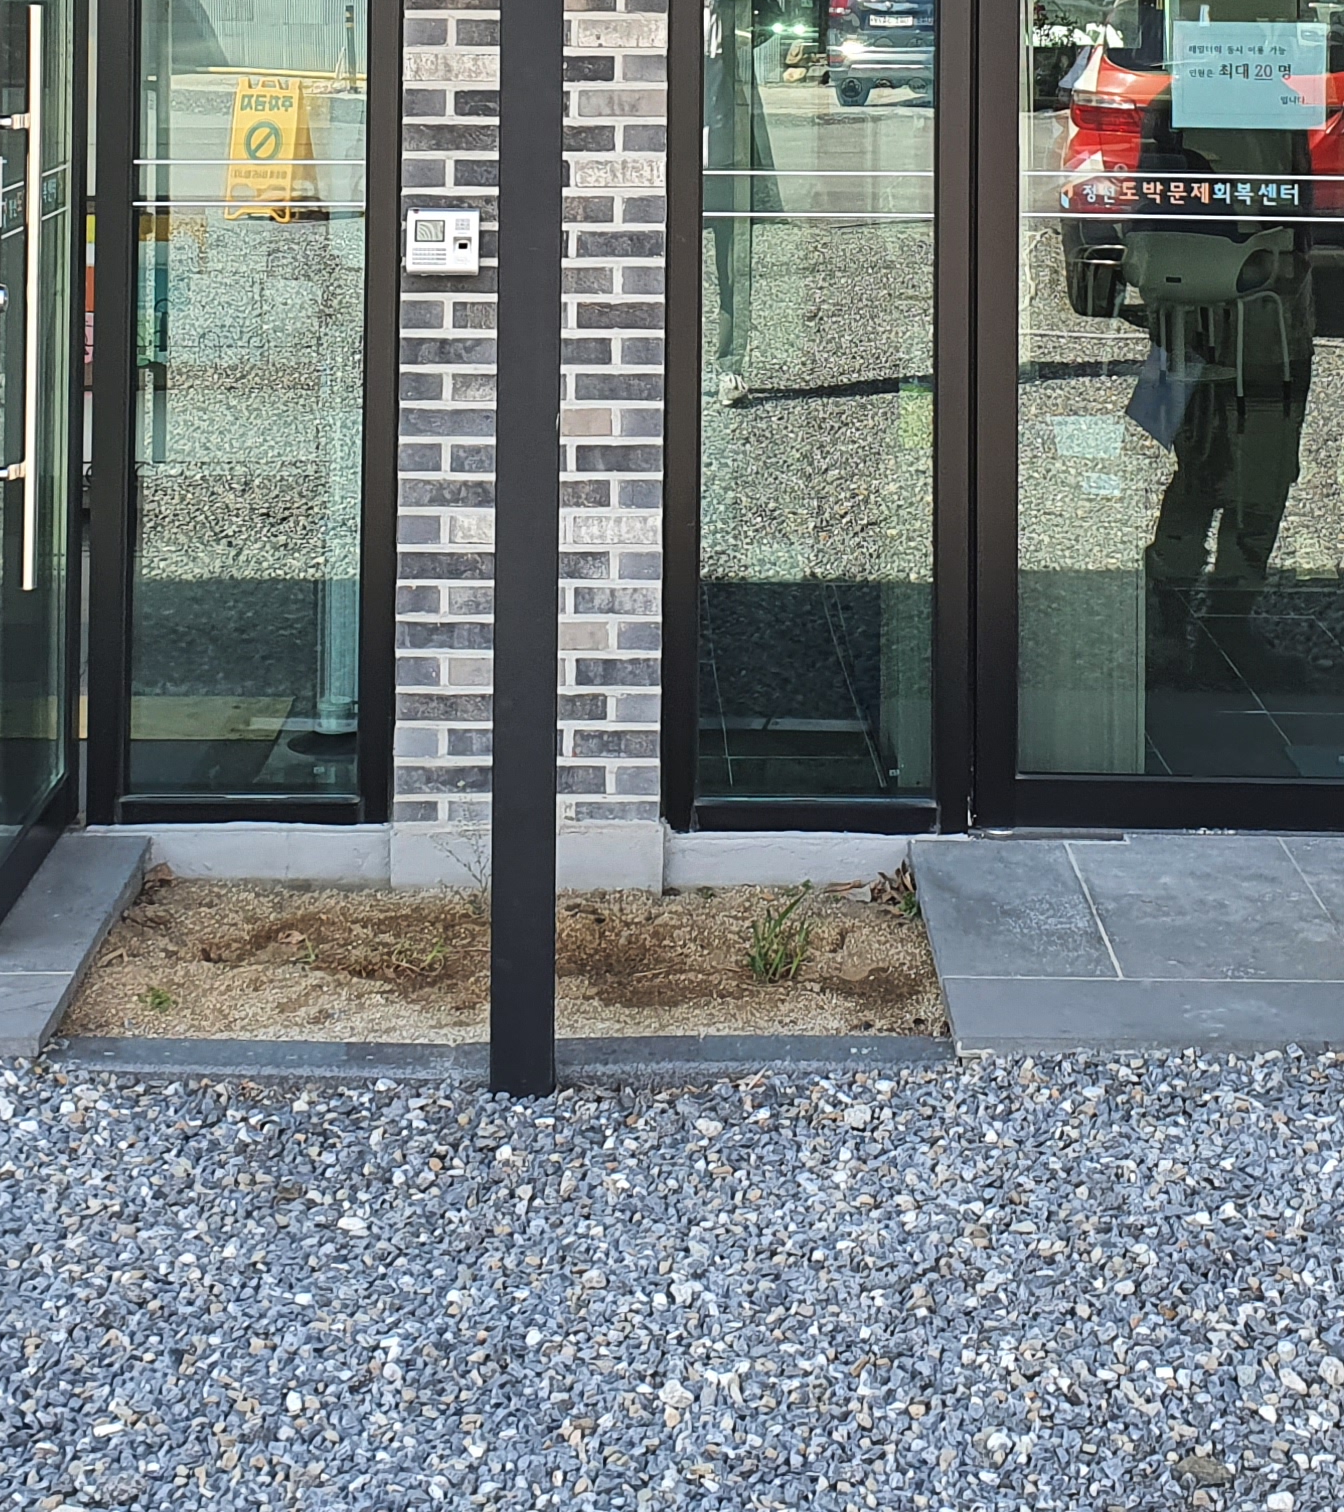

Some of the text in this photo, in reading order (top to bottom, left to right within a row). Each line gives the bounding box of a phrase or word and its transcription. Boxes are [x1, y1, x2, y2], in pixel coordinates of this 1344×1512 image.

[1218, 63, 1250, 80] 최대
[1254, 64, 1273, 79] 20
[1278, 63, 1292, 80] 명
